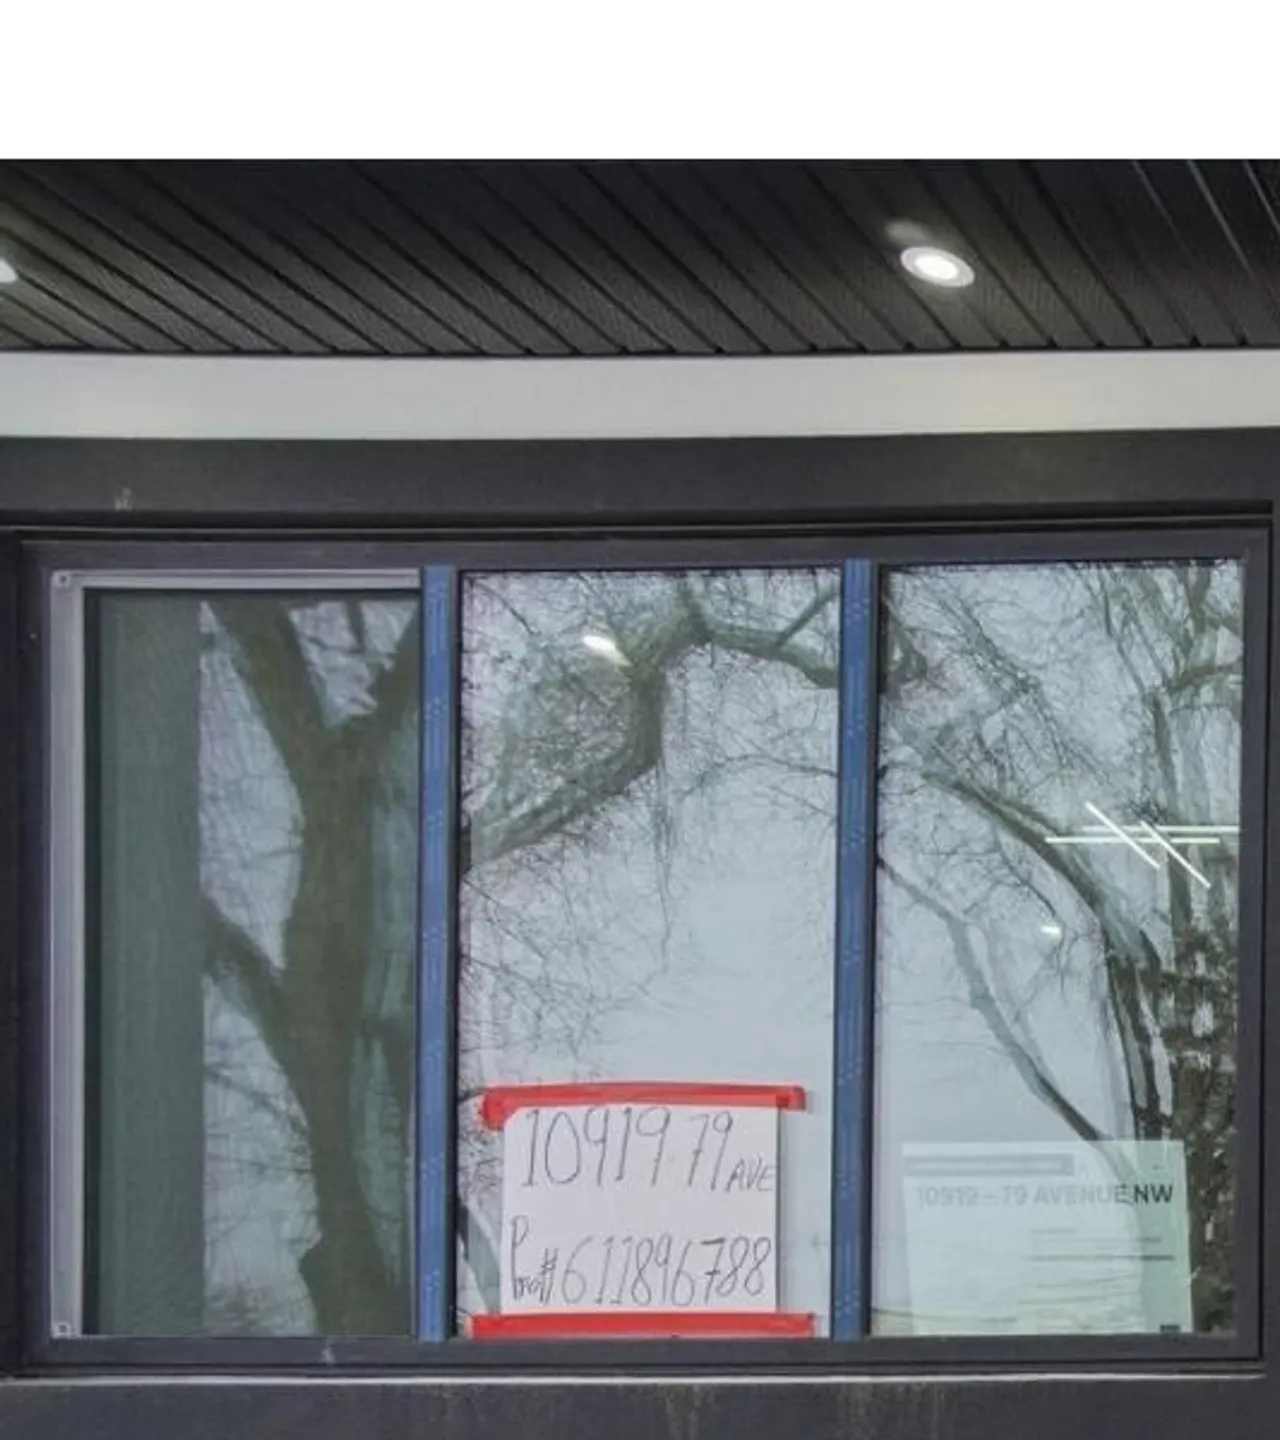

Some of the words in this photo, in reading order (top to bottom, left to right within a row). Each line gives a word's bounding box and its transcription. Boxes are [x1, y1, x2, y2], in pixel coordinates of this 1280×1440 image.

[521, 1106, 671, 1190] 10919
[688, 1110, 733, 1192] 79
[724, 1156, 775, 1194] AVE
[1033, 1183, 1132, 1206] AVENUE
[1133, 1182, 1174, 1205] NW
